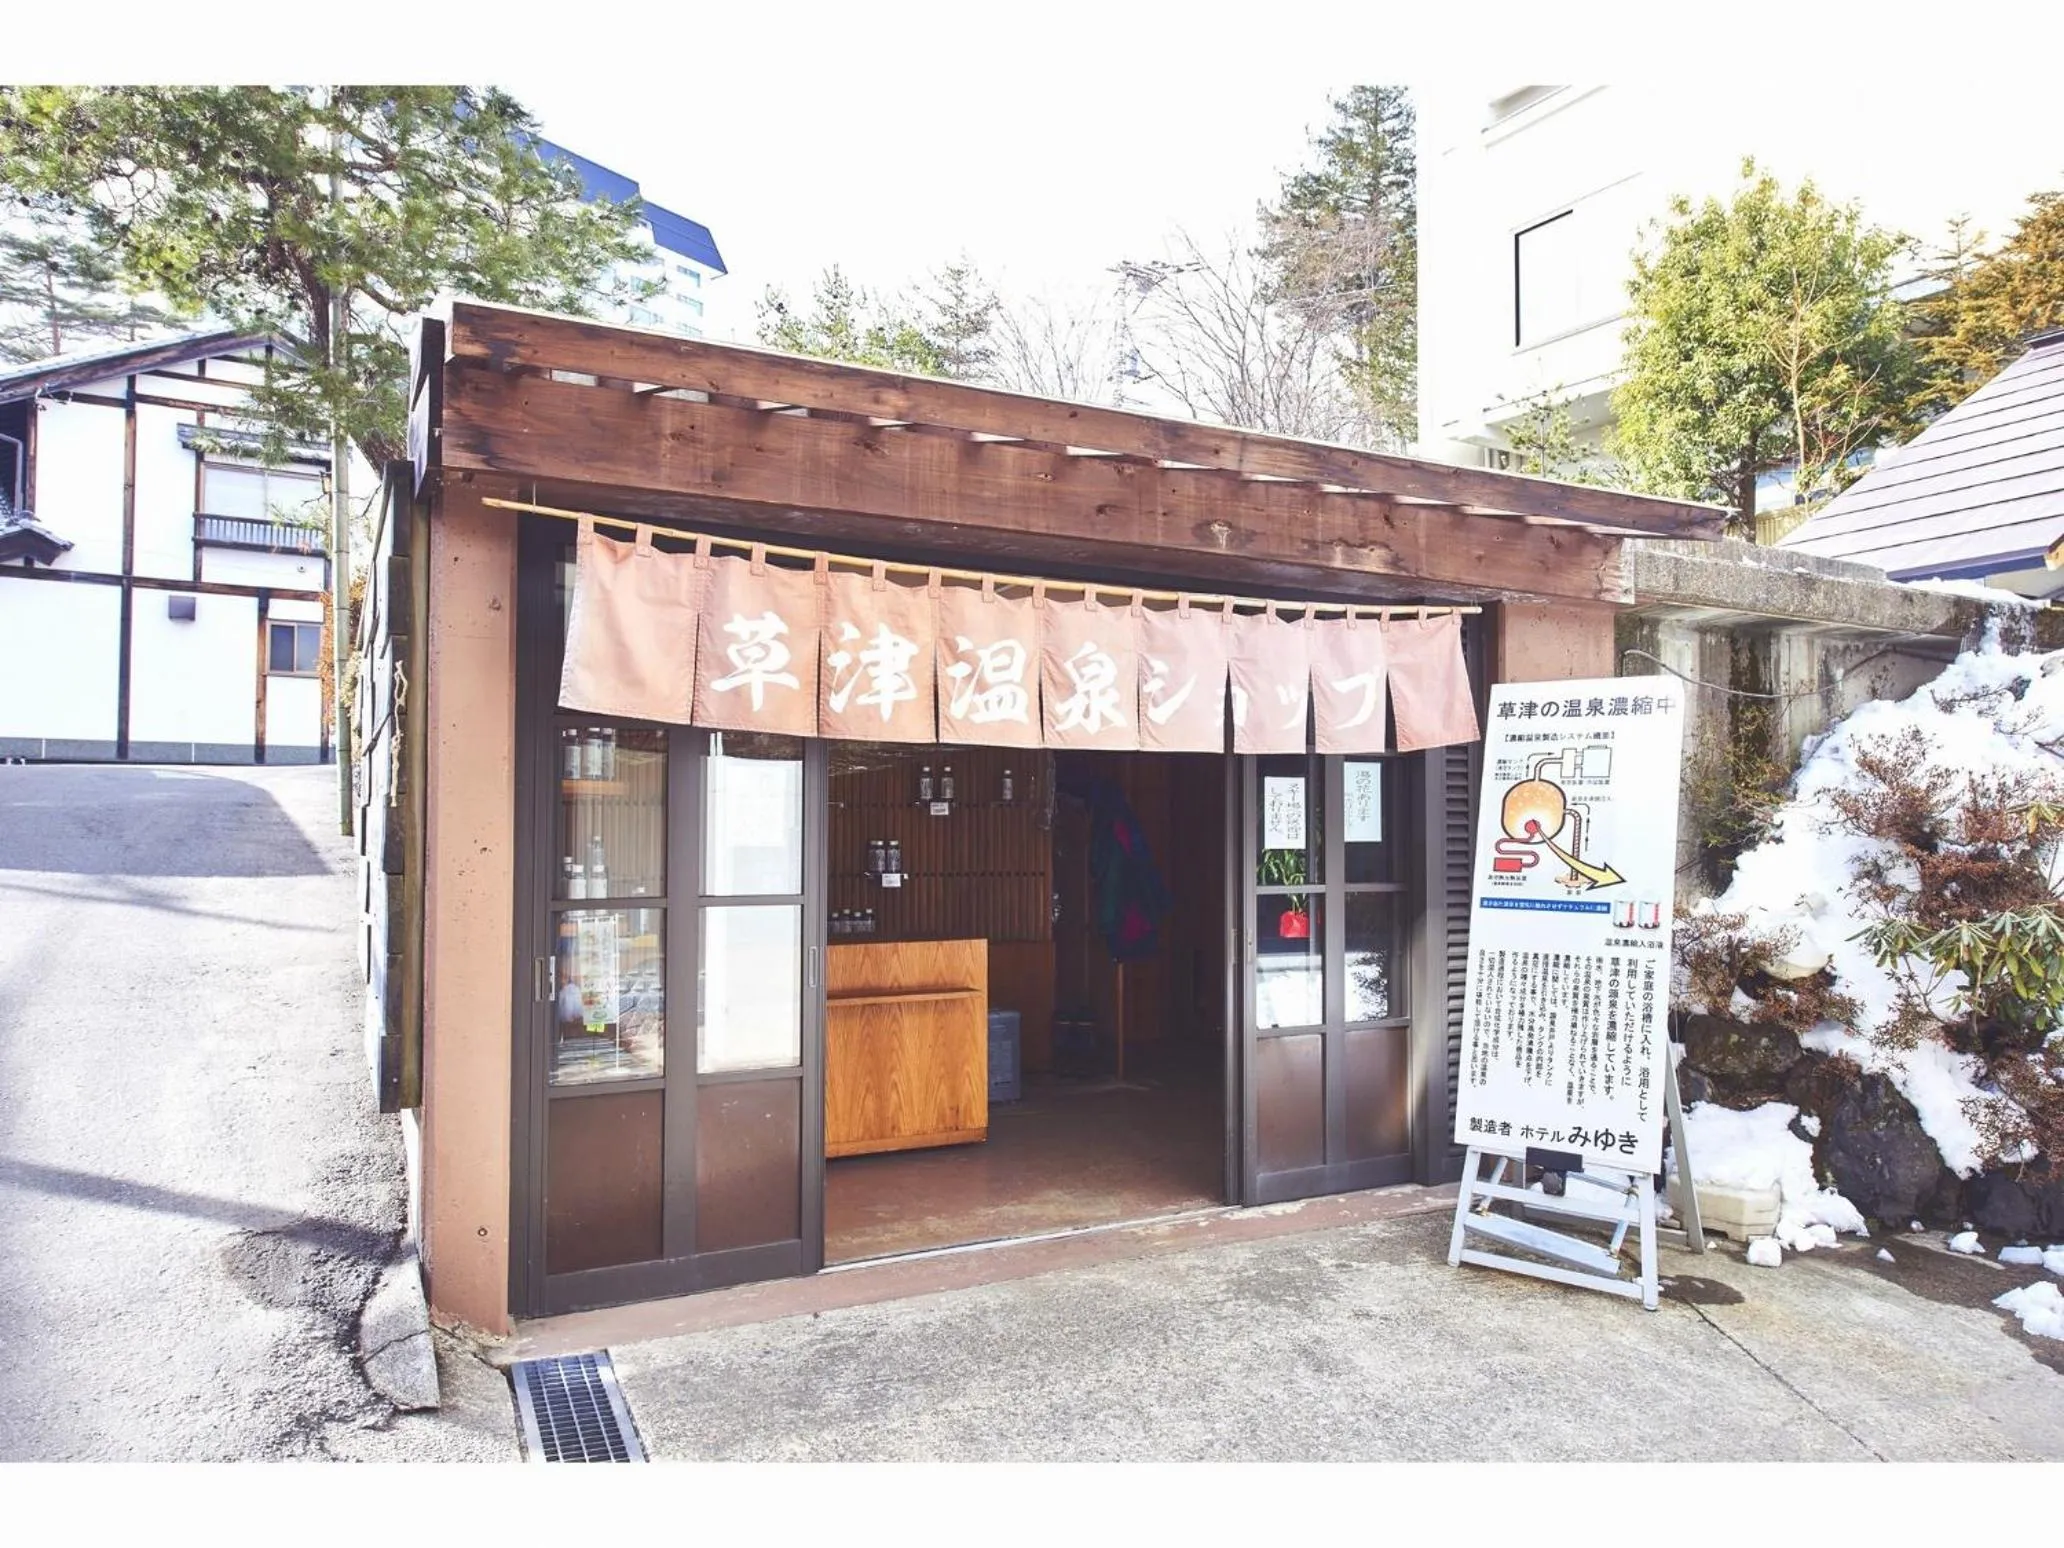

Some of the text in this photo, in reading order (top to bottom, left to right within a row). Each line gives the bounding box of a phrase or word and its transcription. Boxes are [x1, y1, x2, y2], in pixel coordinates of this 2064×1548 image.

[710, 611, 1383, 732] 草津温泉ショップ
[1496, 694, 1676, 720] 草津の温泉濃縮中
[1620, 957, 1639, 1087] 利用していただけるように
[1468, 1116, 1513, 1137] 製造者
